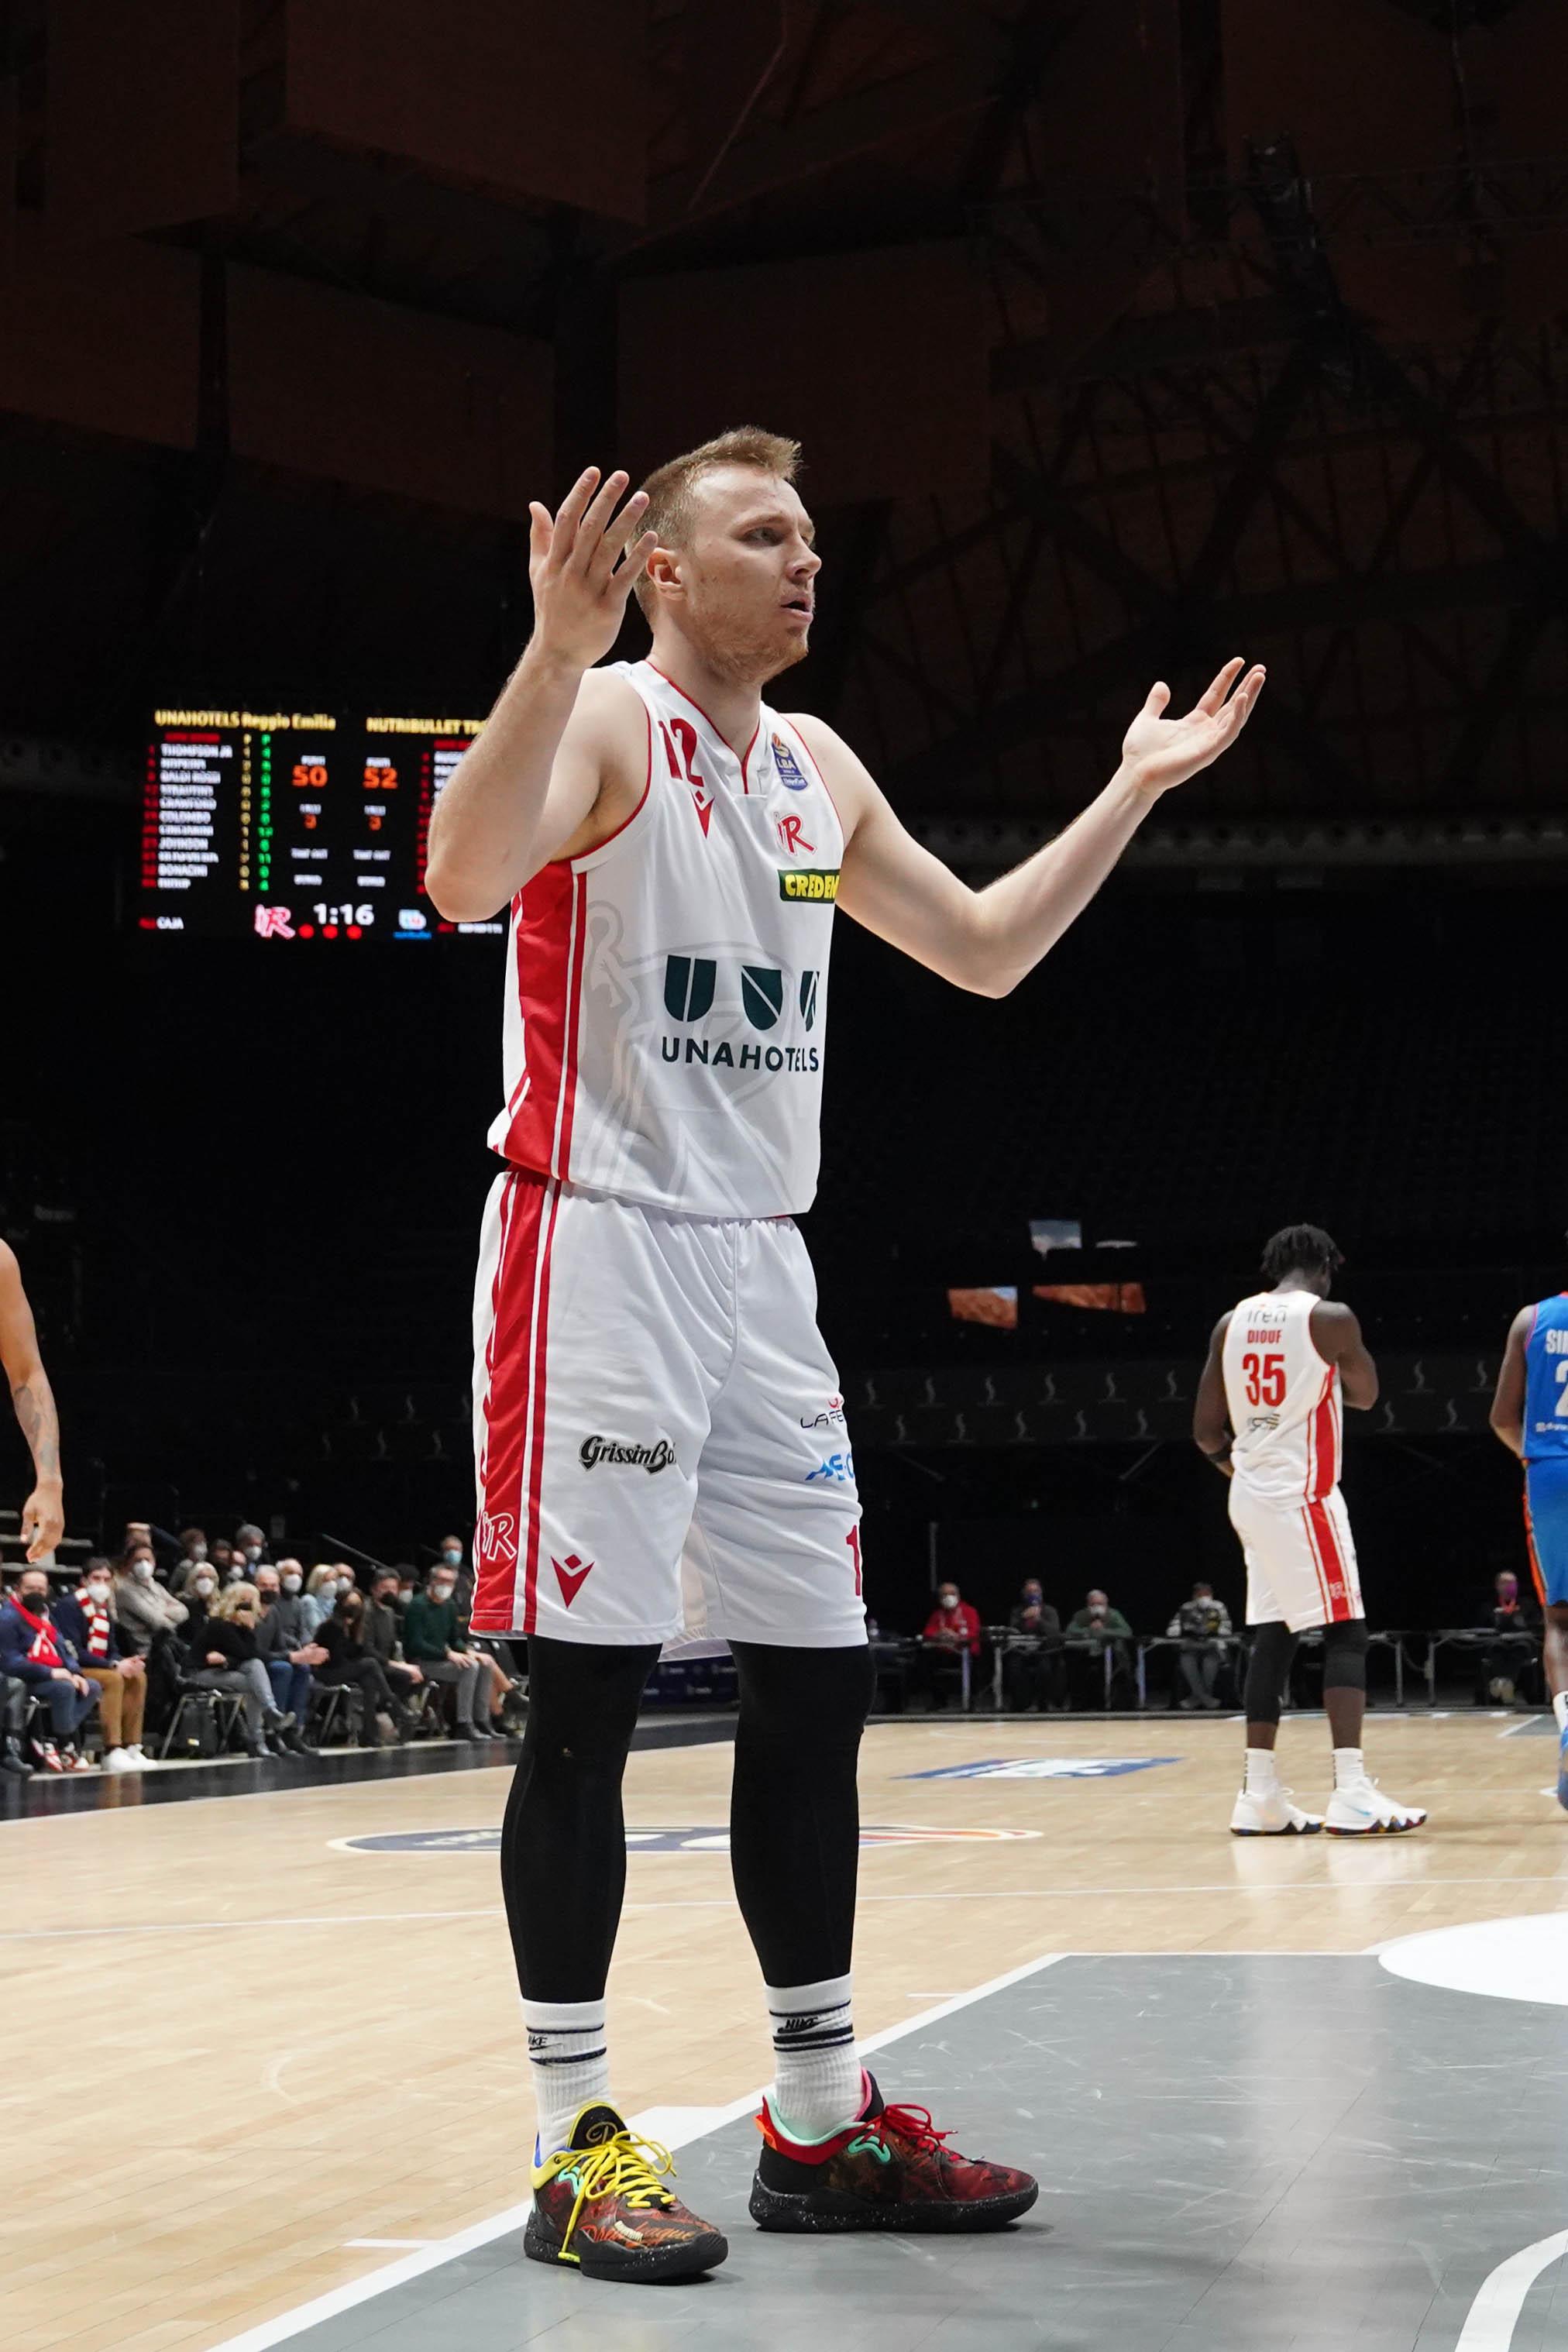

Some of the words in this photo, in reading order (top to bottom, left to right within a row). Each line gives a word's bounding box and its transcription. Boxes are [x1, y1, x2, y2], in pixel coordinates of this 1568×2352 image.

[155, 709, 240, 728] UNAHOTELS
[658, 718, 704, 788] 12
[776, 758, 797, 769] LBA
[291, 765, 328, 788] 50
[363, 767, 398, 789] 52
[313, 903, 375, 926] 1:16
[662, 1037, 820, 1073] UNAHOTELS
[1247, 1329, 1281, 1344] DIOUF
[1243, 1353, 1286, 1407] 35
[579, 1435, 676, 1474] GrissinBo
